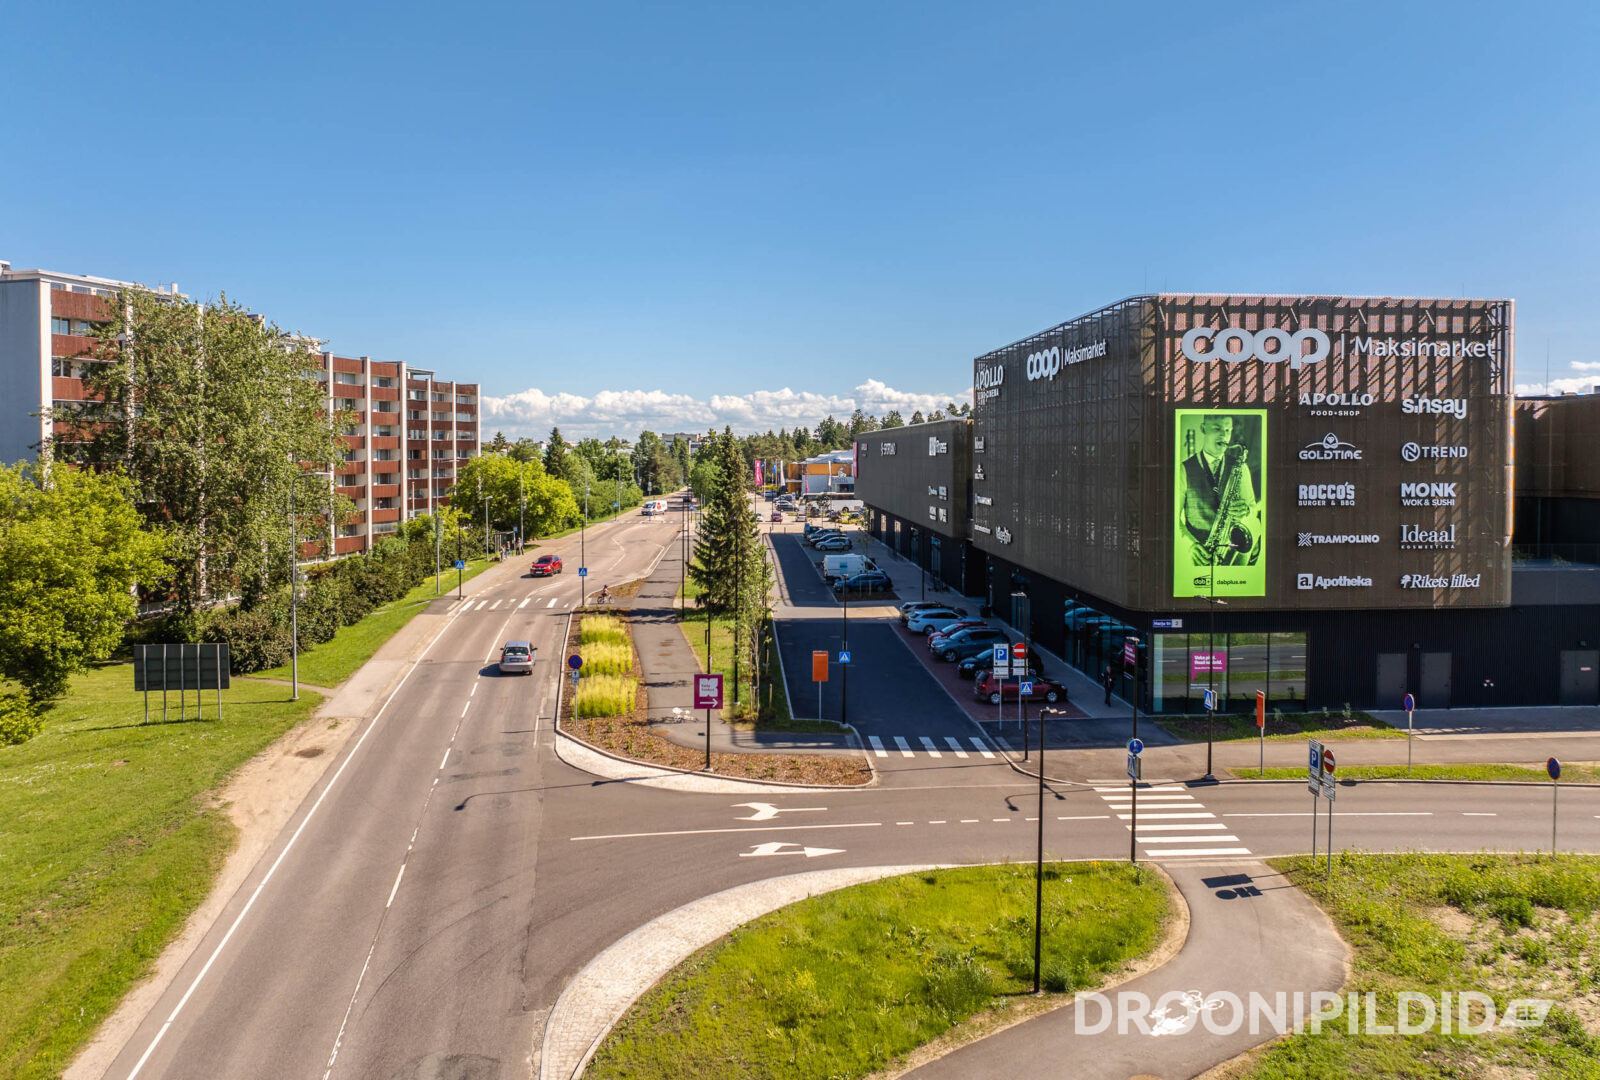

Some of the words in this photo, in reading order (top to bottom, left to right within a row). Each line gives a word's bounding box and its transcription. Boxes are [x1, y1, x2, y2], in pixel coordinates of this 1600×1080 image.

[1181, 327, 1330, 370] coop
[1355, 335, 1496, 358] Maksimarket
[1027, 346, 1060, 381] coop
[1064, 339, 1106, 366] Maksimarket
[975, 365, 1004, 390] APOLLO
[1299, 393, 1373, 406] APOLLO
[1402, 394, 1467, 420] sinsay
[1299, 450, 1363, 460] GOLDTIME
[1422, 446, 1468, 458] TREND
[1401, 483, 1457, 498] MONK
[1312, 534, 1380, 544] TRAMPOLINO
[1401, 524, 1456, 543] Ideaal
[1315, 576, 1373, 589] Apotheka
